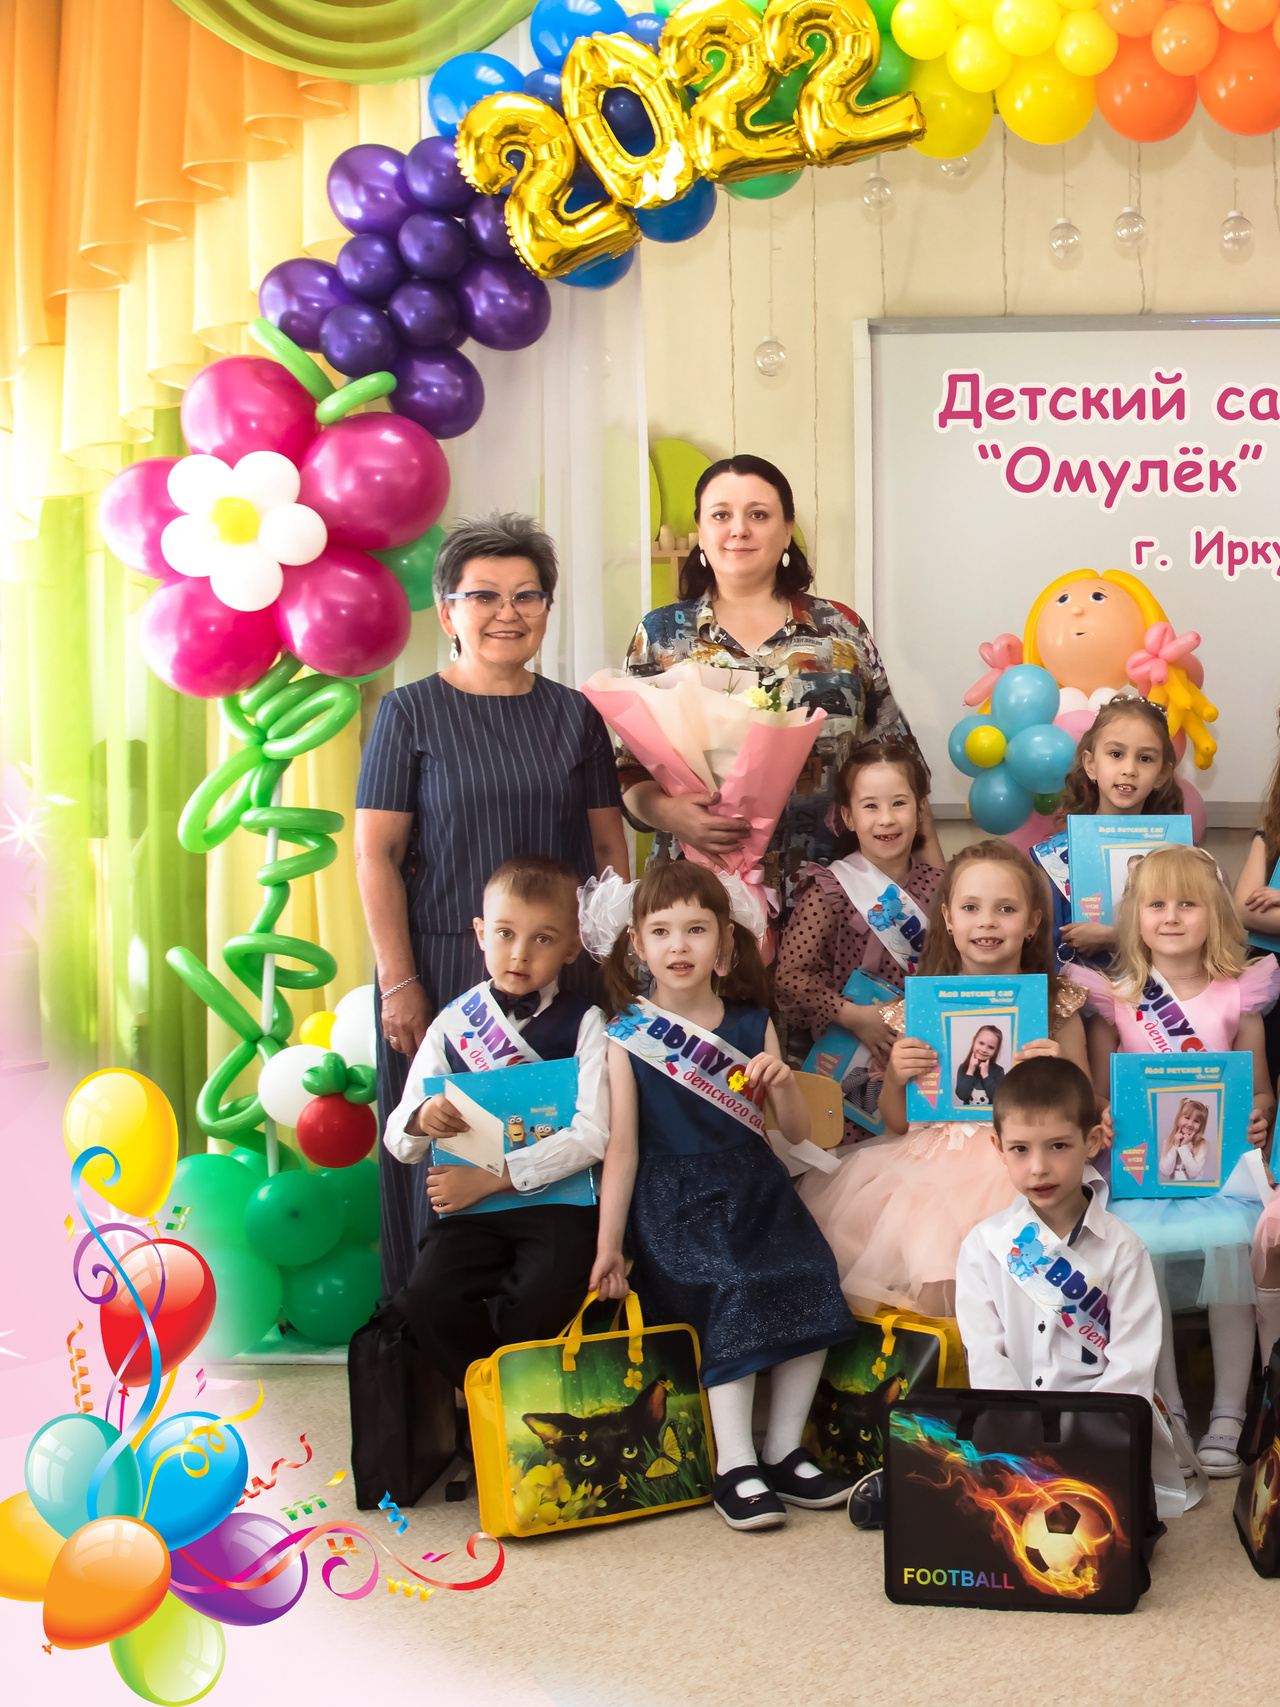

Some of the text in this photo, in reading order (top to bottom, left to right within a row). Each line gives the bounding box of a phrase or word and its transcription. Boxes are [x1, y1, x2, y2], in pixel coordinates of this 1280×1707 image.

[454, 0, 927, 280] 2022
[683, 1065, 749, 1118] детского
[903, 1567, 1015, 1590] FOOTBALL
